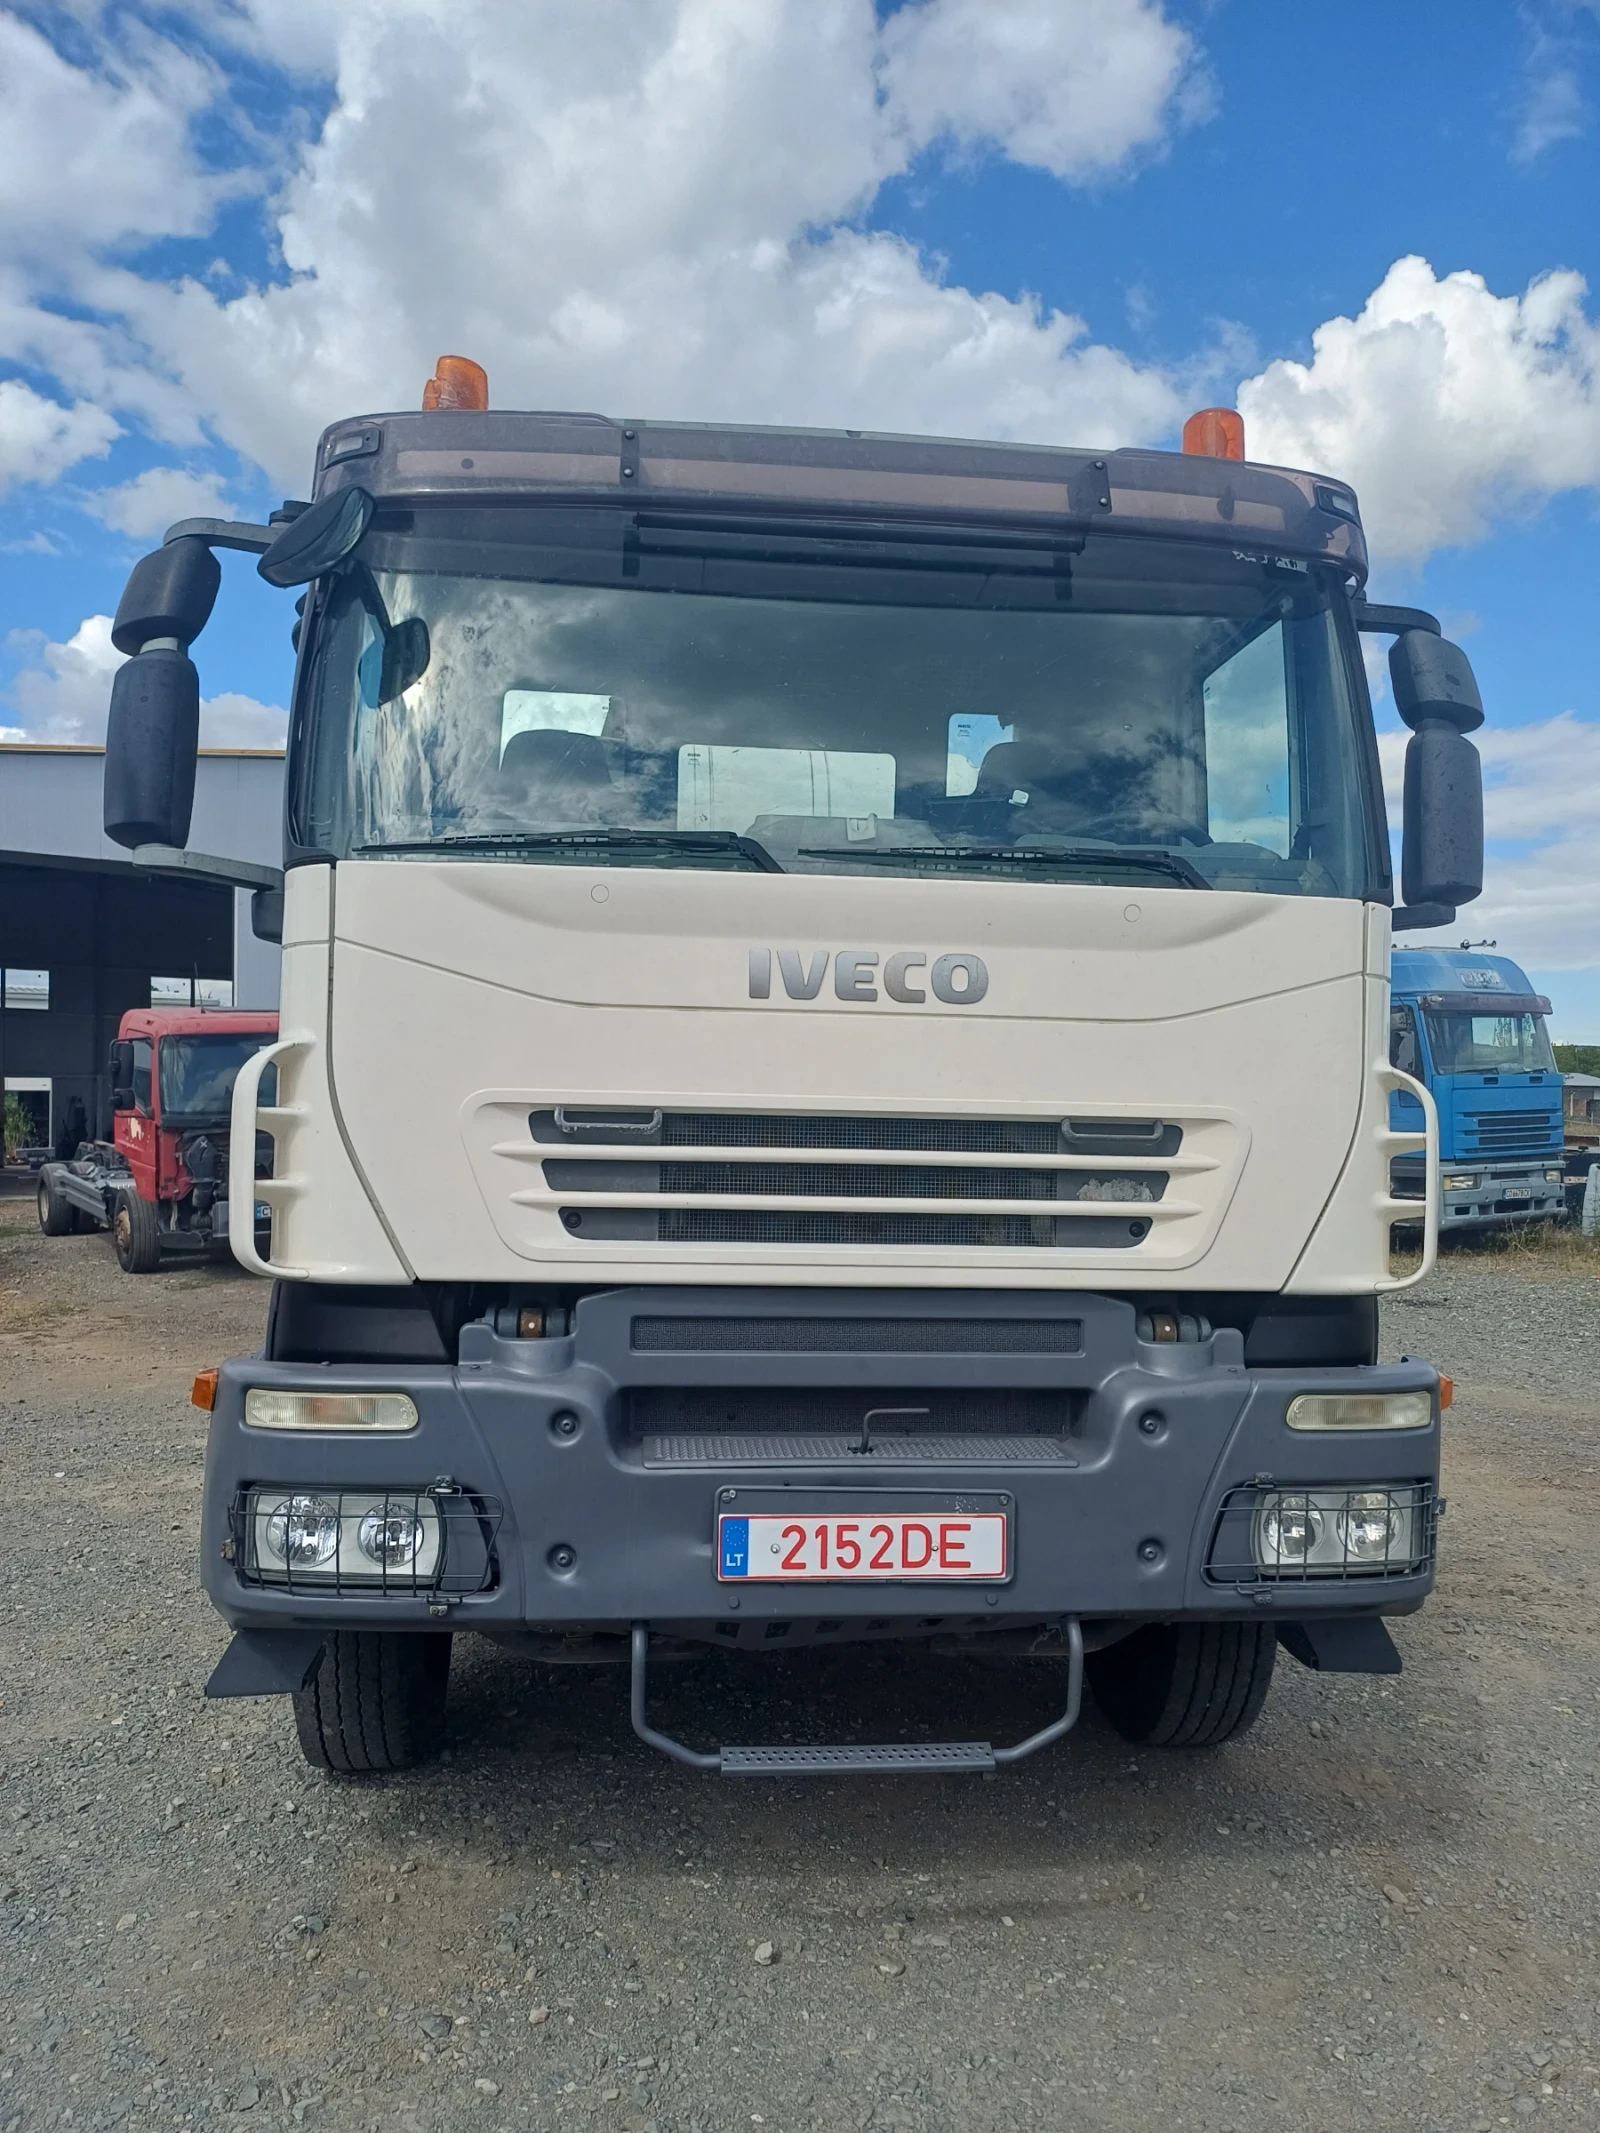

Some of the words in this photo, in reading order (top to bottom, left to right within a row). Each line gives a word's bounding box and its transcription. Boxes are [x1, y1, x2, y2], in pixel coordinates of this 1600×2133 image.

[748, 947, 989, 1005] IVECO
[725, 1554, 745, 1567] LT
[780, 1523, 972, 1570] 2152DE
